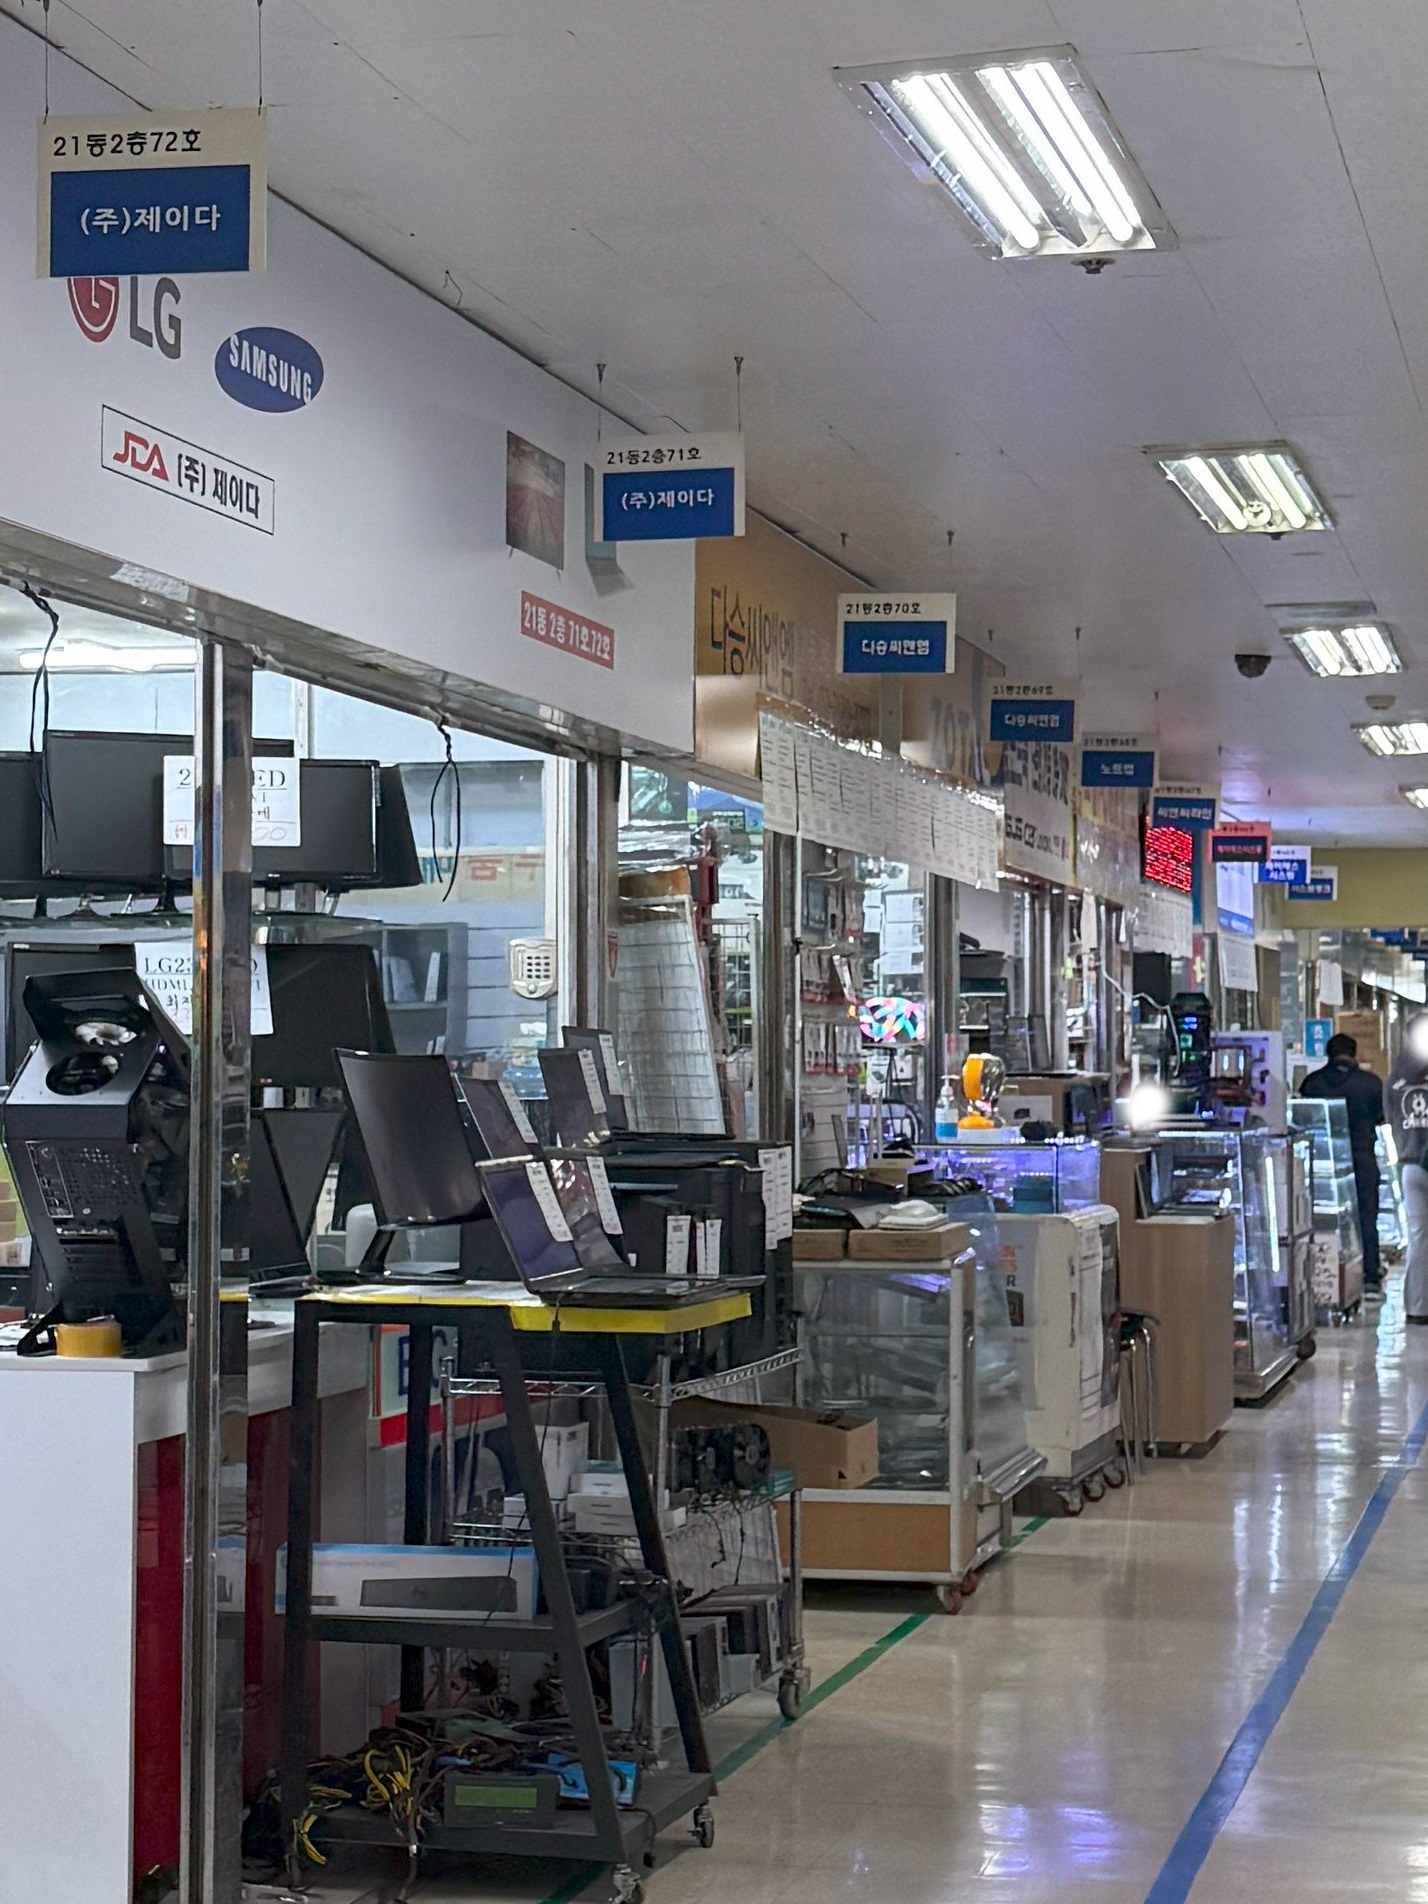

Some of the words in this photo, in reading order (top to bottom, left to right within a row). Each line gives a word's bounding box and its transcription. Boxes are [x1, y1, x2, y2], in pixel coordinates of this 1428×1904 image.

[53, 129, 202, 157] 21동2층72호
[80, 203, 221, 236] (주)제이다
[129, 276, 182, 360] LG
[228, 333, 313, 405] SAMSUNG
[606, 446, 703, 466] 21동2층71호
[176, 452, 207, 498] (주)
[212, 467, 261, 520] 제이다
[621, 487, 715, 510] (주)제이다
[522, 600, 549, 634] 21동
